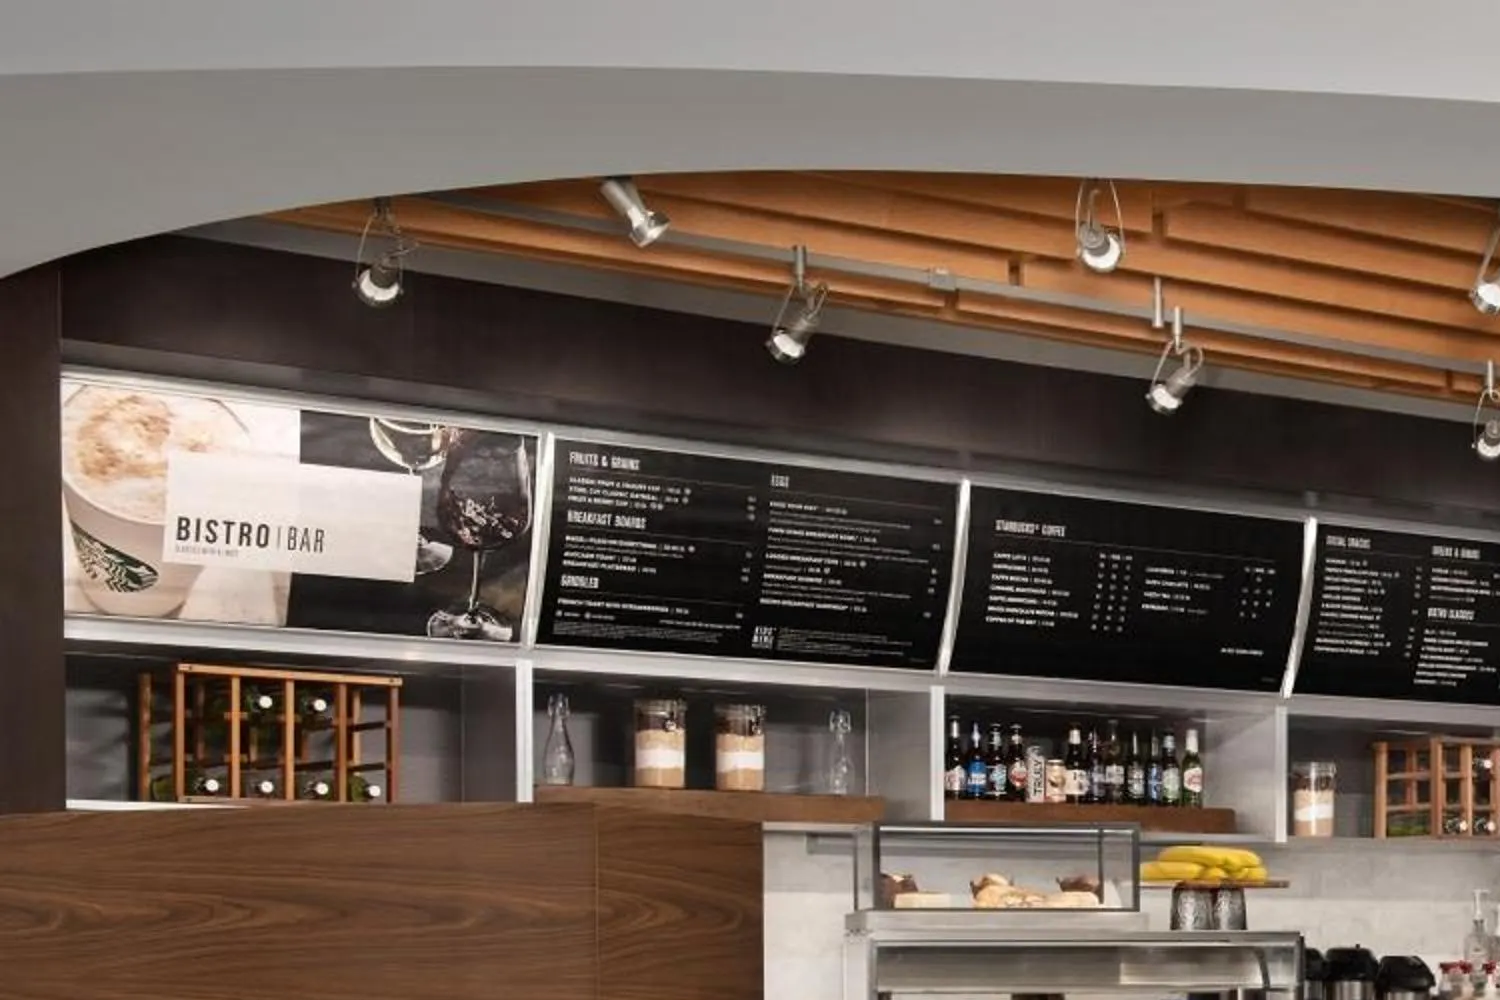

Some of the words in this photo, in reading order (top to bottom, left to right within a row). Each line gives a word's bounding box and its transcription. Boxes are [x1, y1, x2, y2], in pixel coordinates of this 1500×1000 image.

[569, 451, 598, 468] FRUITS
[567, 509, 612, 527] BREAKFAST
[176, 516, 270, 549] BISTRO
[287, 526, 325, 553] BAR
[1033, 759, 1043, 796] TRULY
